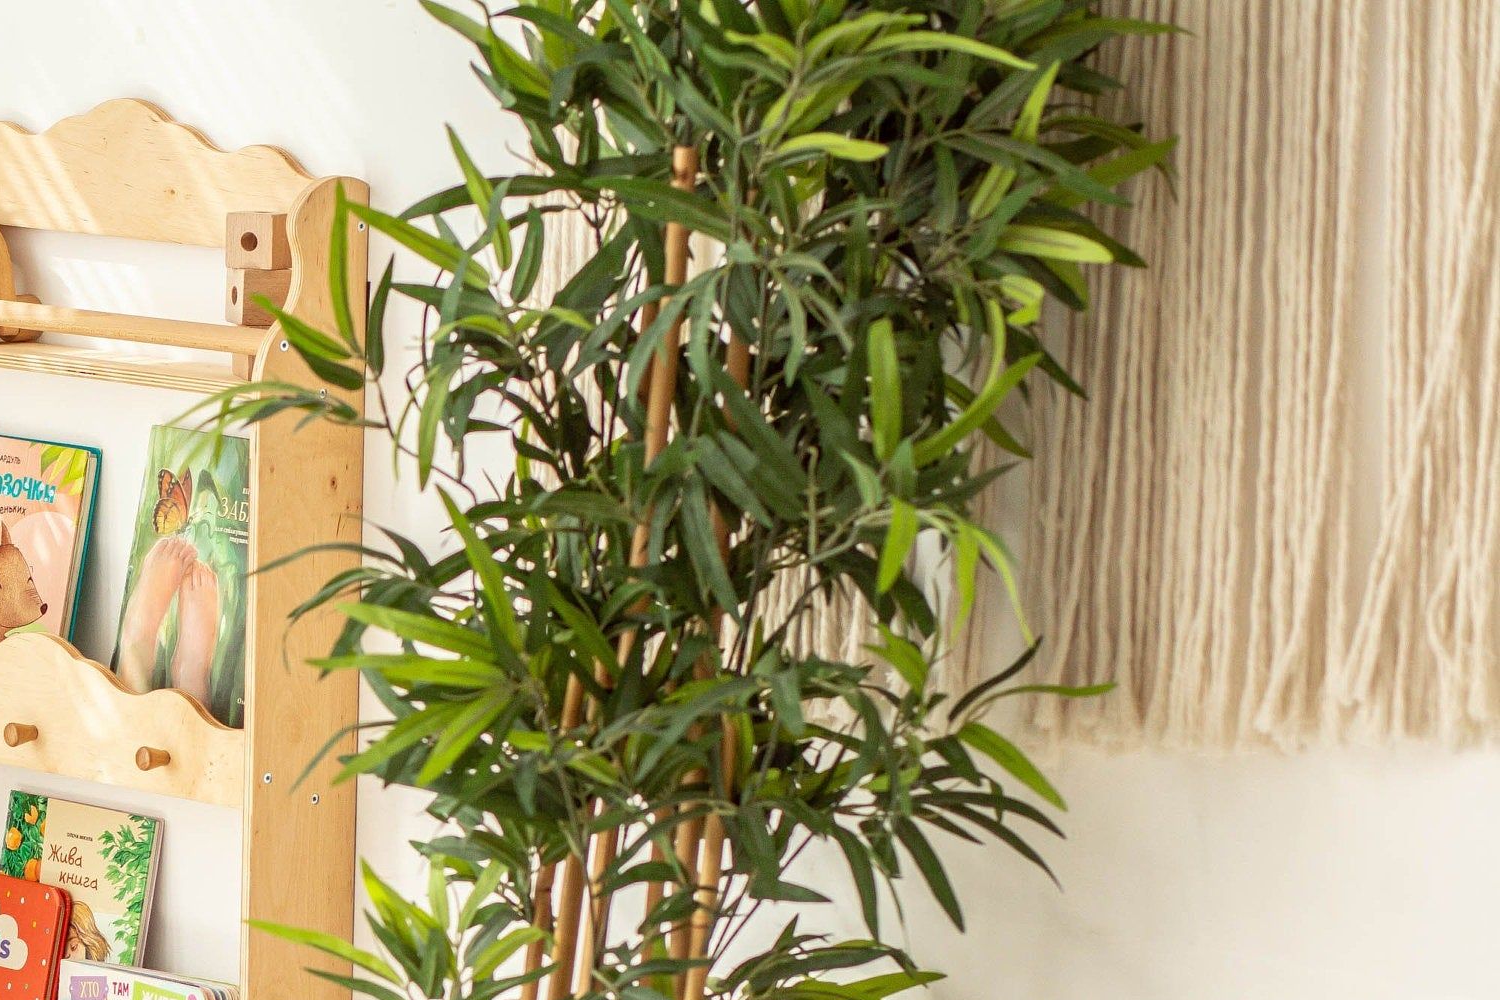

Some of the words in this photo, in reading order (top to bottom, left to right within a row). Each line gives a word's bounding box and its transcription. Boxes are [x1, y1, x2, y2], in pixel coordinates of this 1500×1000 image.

[48, 844, 82, 868] Жива
[59, 870, 98, 891] книга
[80, 981, 100, 998] ХТО
[112, 981, 130, 997] ТАМ
